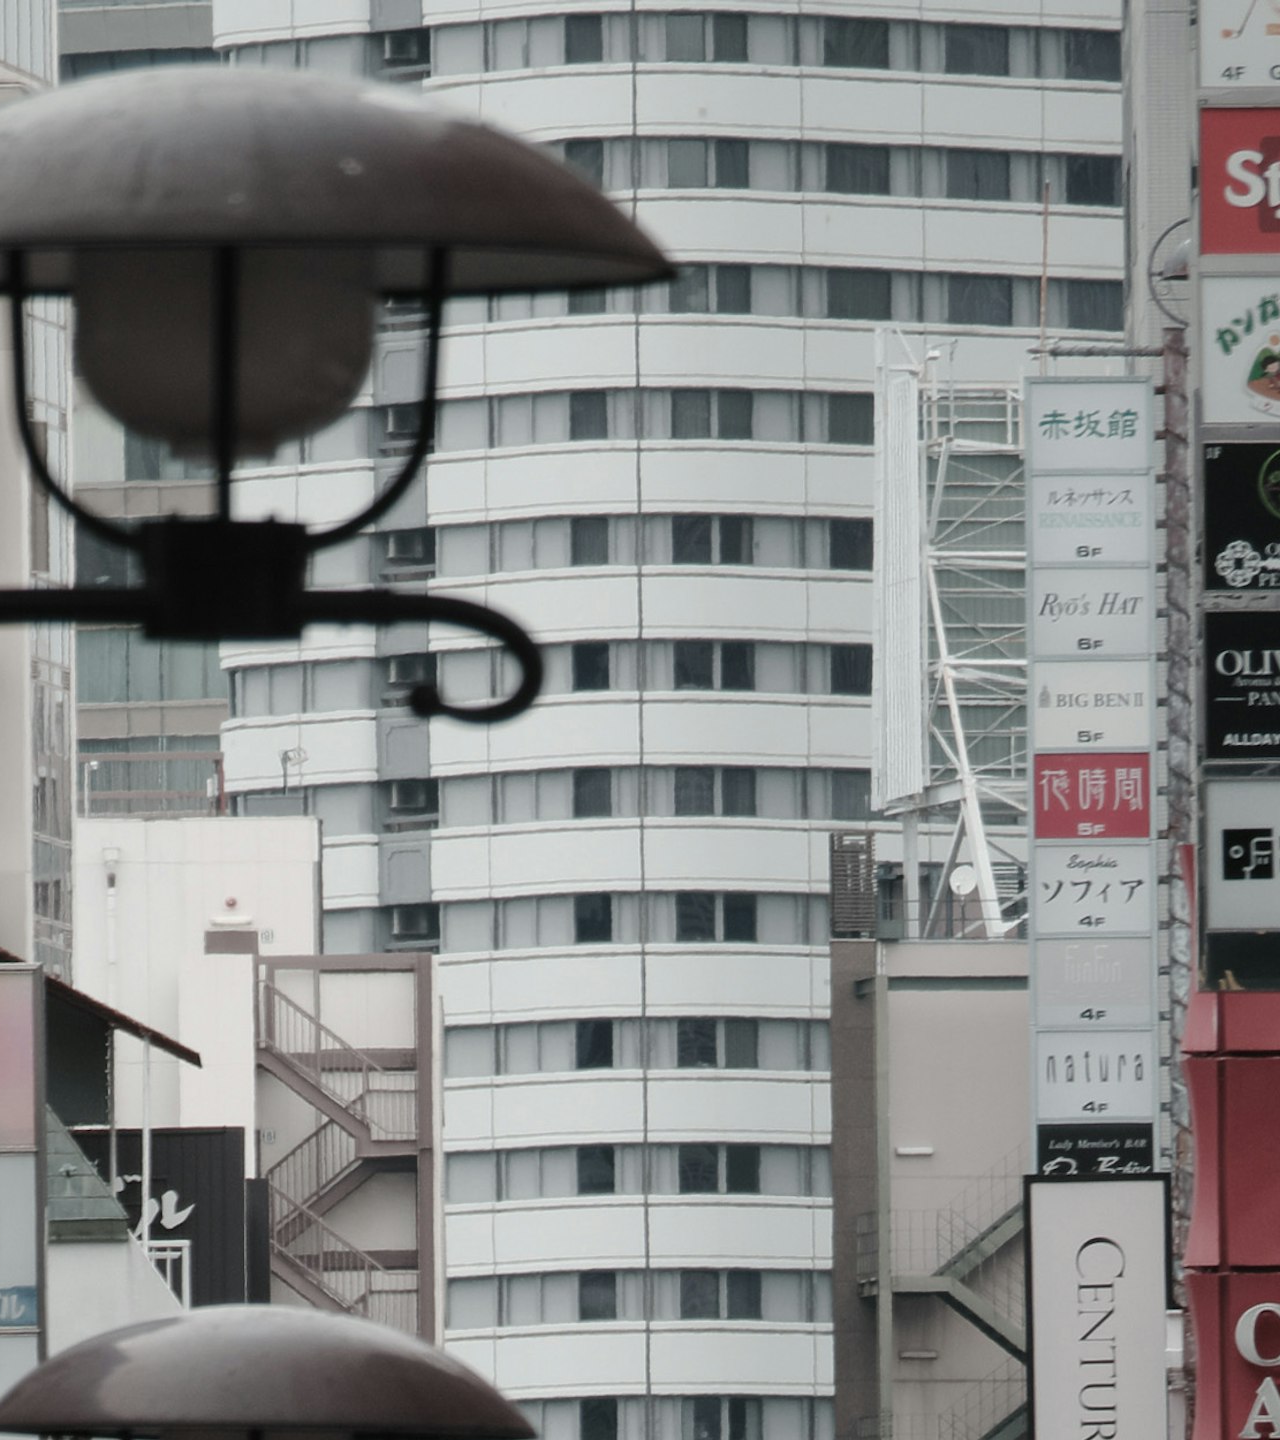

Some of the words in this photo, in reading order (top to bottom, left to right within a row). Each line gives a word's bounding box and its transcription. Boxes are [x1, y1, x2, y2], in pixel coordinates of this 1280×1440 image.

[1221, 66, 1245, 79] 4F
[1039, 409, 1139, 440] 赤坂館
[1048, 489, 1133, 505] ルネッサンス
[1039, 512, 1142, 529] RENAISSANCE
[1076, 546, 1103, 558] 6F
[1097, 592, 1143, 616] HAT
[1078, 638, 1104, 650] 6F
[1056, 693, 1089, 707] BIG
[1093, 693, 1131, 707] BEN
[1078, 731, 1104, 742] 5F
[1039, 768, 1144, 813] 花時間
[1077, 822, 1105, 836] 5F
[1044, 880, 1145, 903] ソフィア
[1079, 915, 1107, 927] 4F
[1080, 1008, 1108, 1021] 4F
[1046, 1051, 1145, 1083] natura
[1081, 1101, 1109, 1114] 4F
